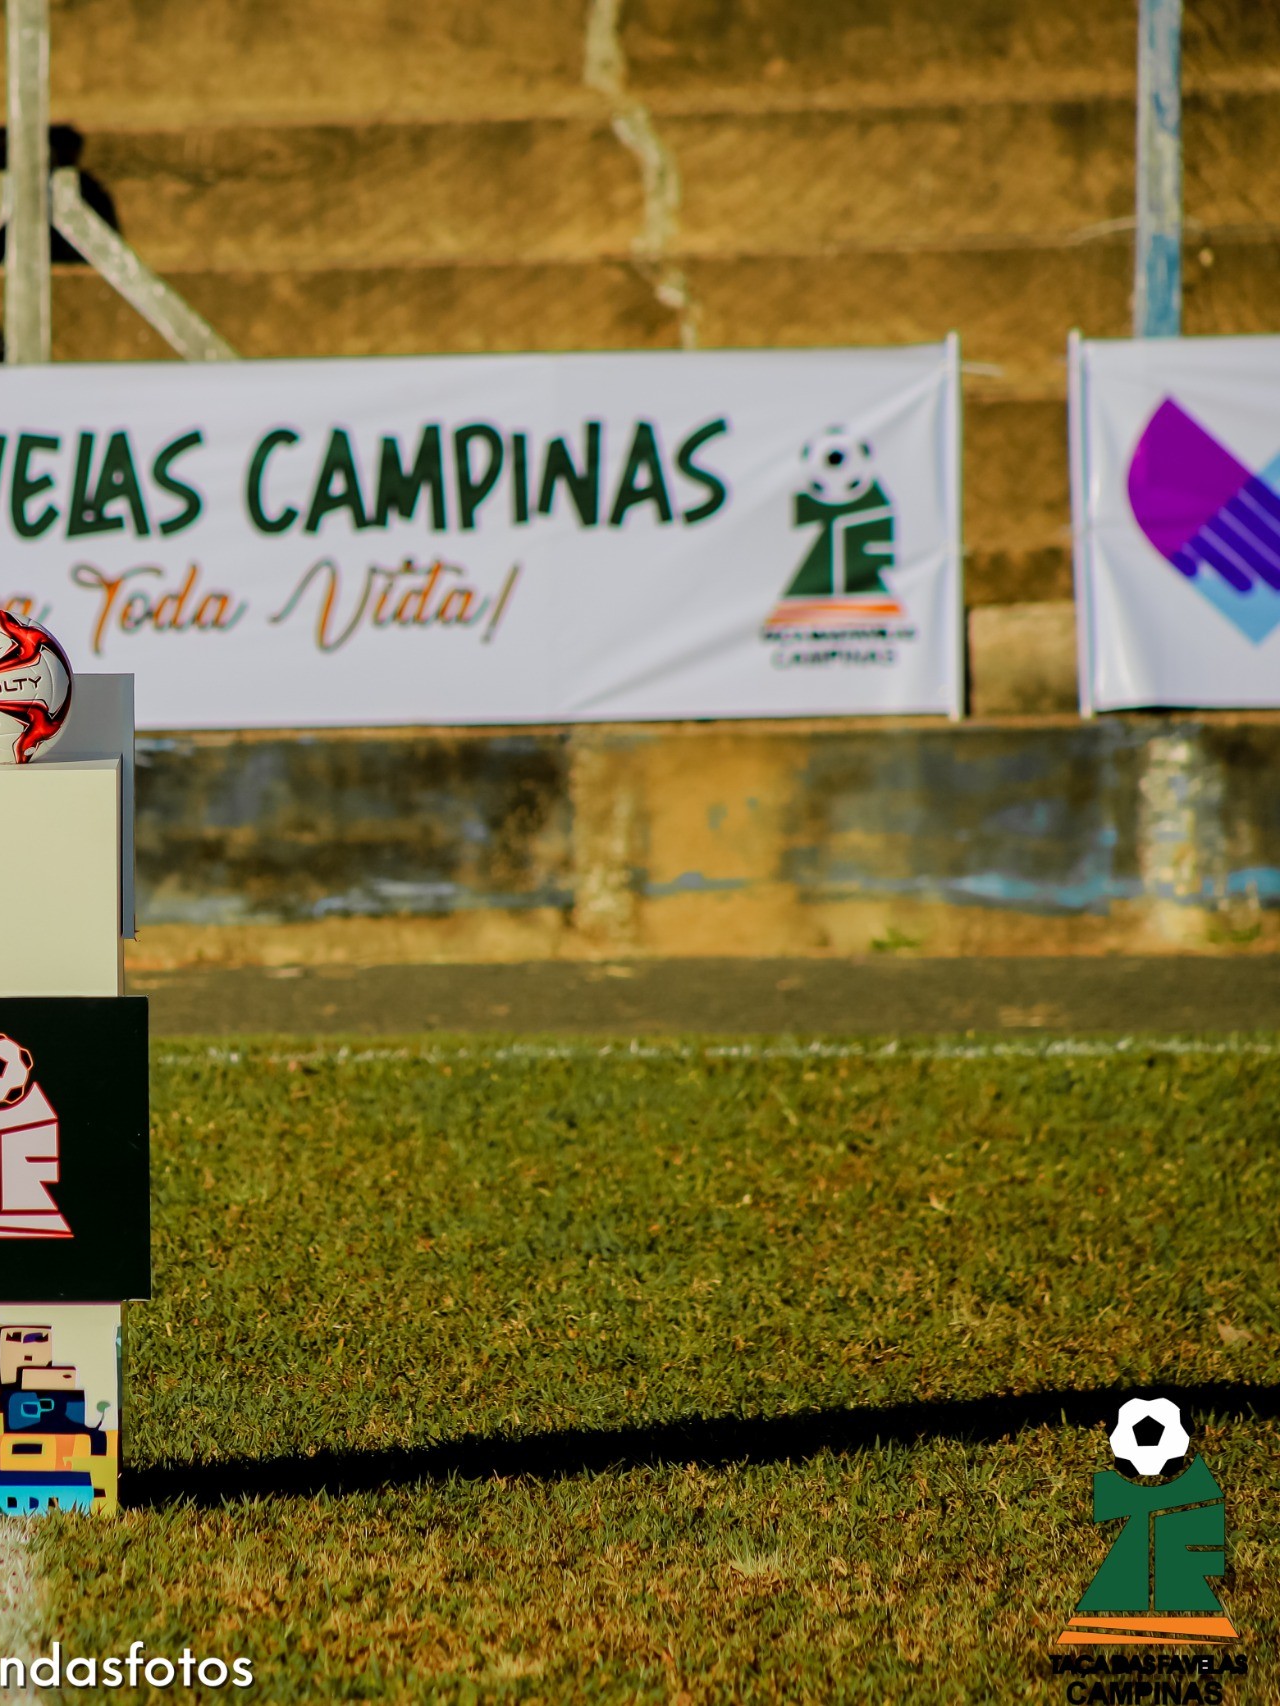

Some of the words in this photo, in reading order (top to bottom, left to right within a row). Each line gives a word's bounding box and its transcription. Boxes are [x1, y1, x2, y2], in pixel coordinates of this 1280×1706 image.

[246, 418, 730, 536] CAMPINAS
[69, 563, 249, 656] Toda
[268, 556, 521, 654] Vida!
